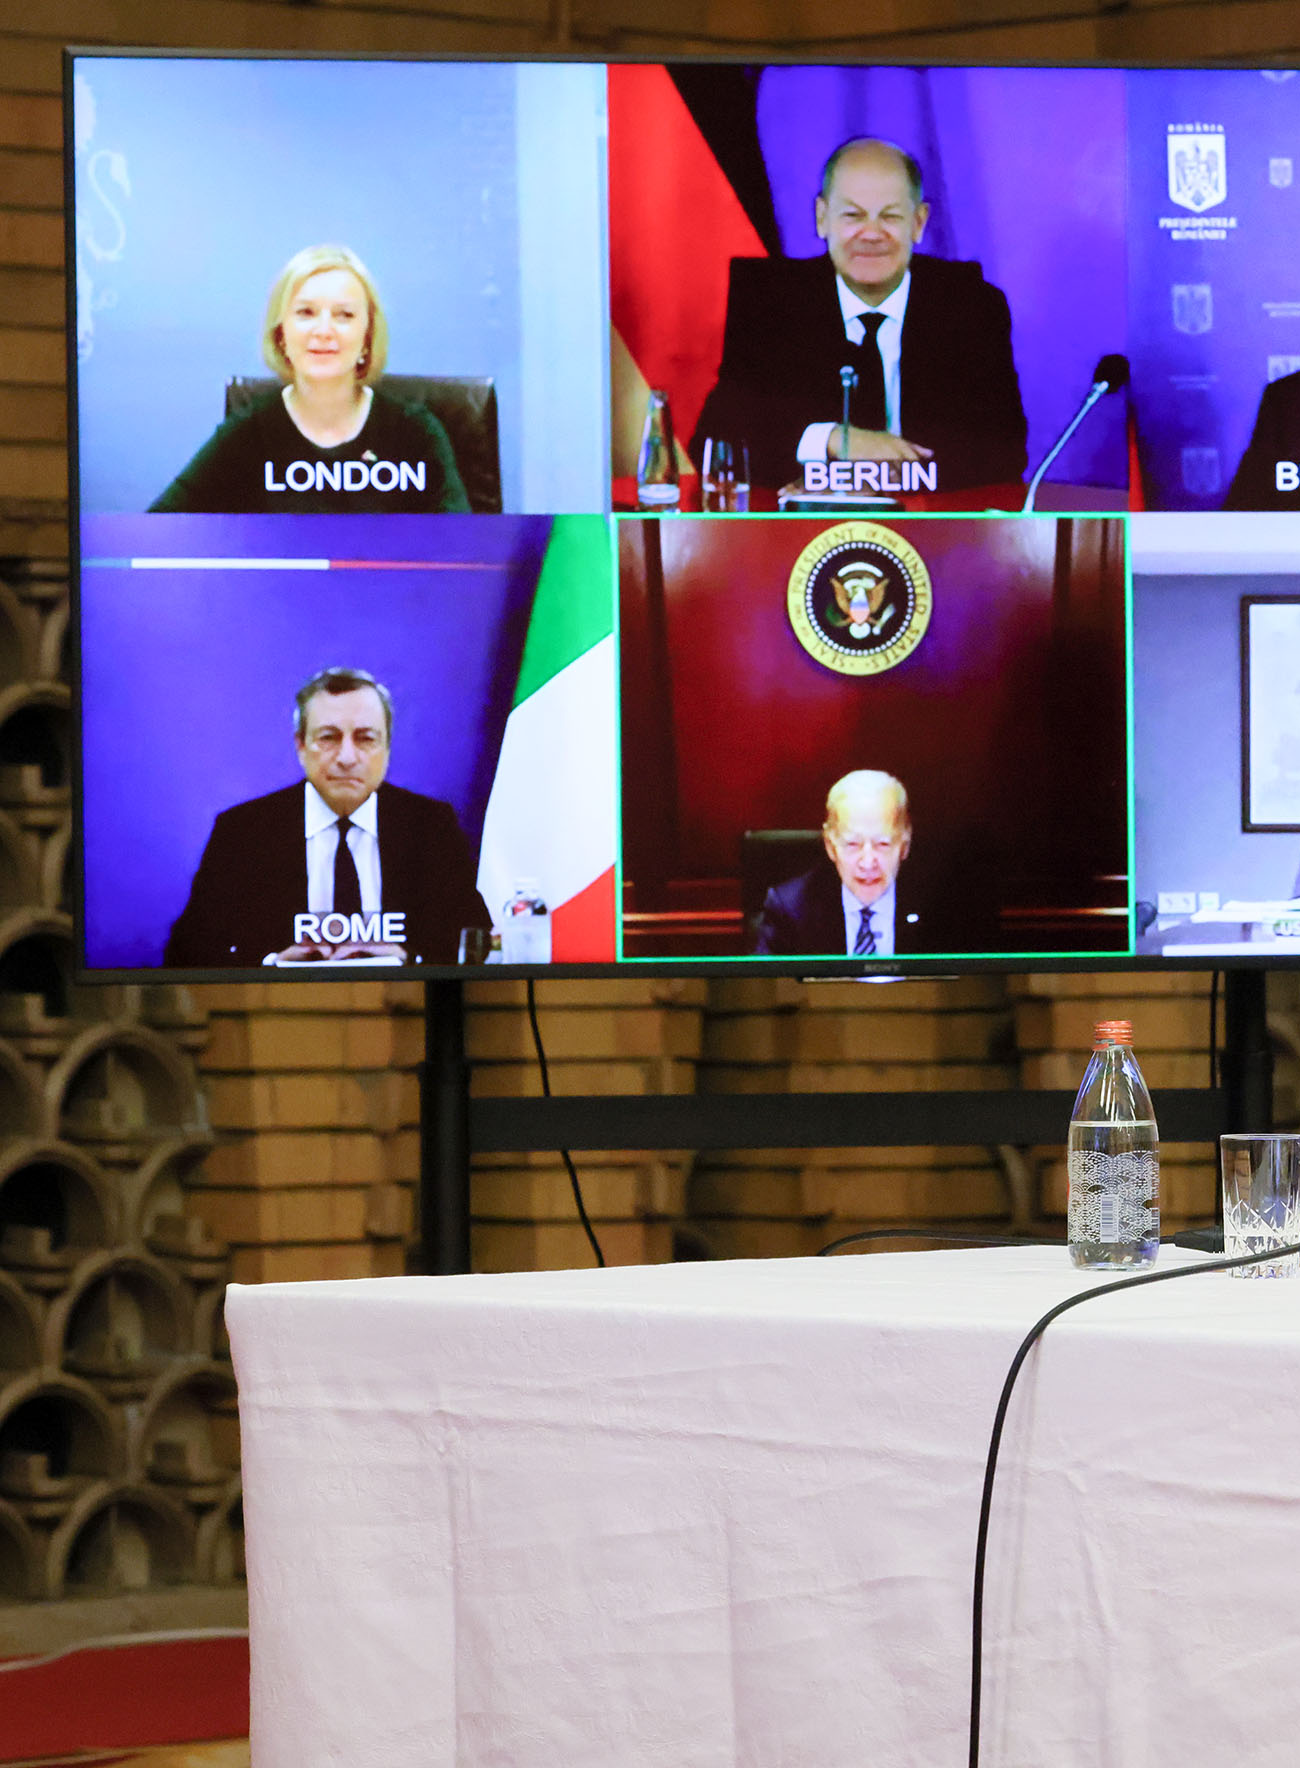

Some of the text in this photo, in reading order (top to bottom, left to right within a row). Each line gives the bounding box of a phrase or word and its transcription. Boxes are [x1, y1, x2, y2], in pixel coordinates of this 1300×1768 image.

[264, 460, 426, 492] LONDON
[804, 461, 937, 492] BERLIN
[902, 550, 928, 616] UNITED
[294, 912, 407, 944] ROME
